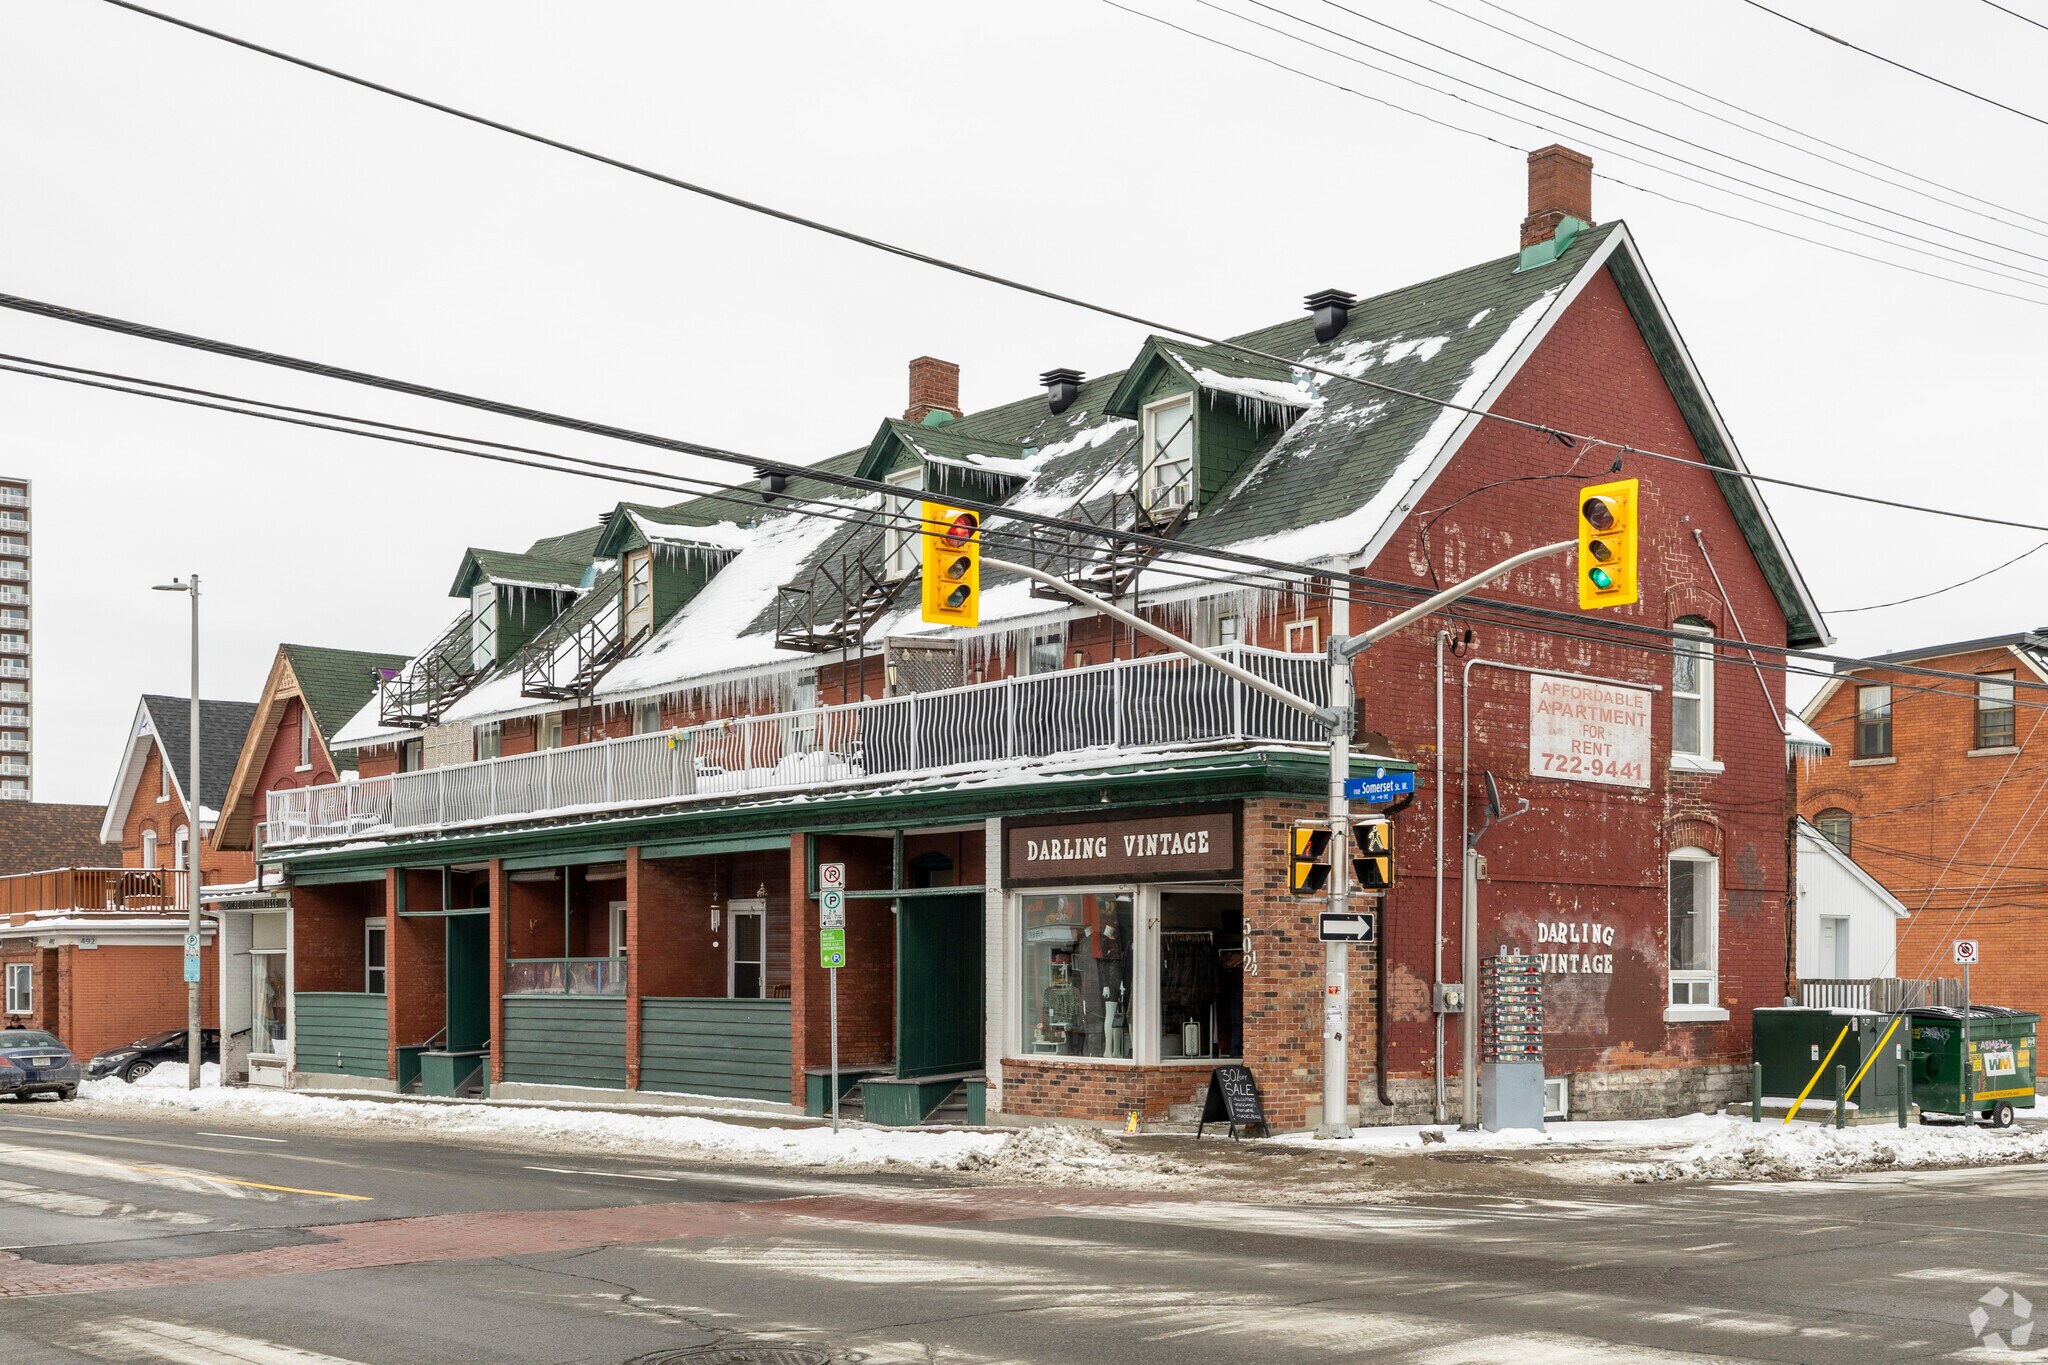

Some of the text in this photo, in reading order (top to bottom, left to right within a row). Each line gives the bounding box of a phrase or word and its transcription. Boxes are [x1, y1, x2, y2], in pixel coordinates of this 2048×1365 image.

[1540, 682, 1643, 708] AFFORDABLE
[1537, 700, 1646, 727] APARTMENT
[1583, 724, 1604, 739] FOR
[1571, 740, 1612, 757] RENT
[1541, 753, 1642, 780] 722-9441
[1362, 780, 1394, 794] Somerset
[1027, 831, 1210, 861] DARLING VINTAGE
[80, 937, 96, 945] 492
[1538, 922, 1615, 946] DARLING
[1538, 953, 1613, 973] VINTAGE
[1988, 1058, 2012, 1071] WM
[1225, 1082, 1255, 1097] SALE
